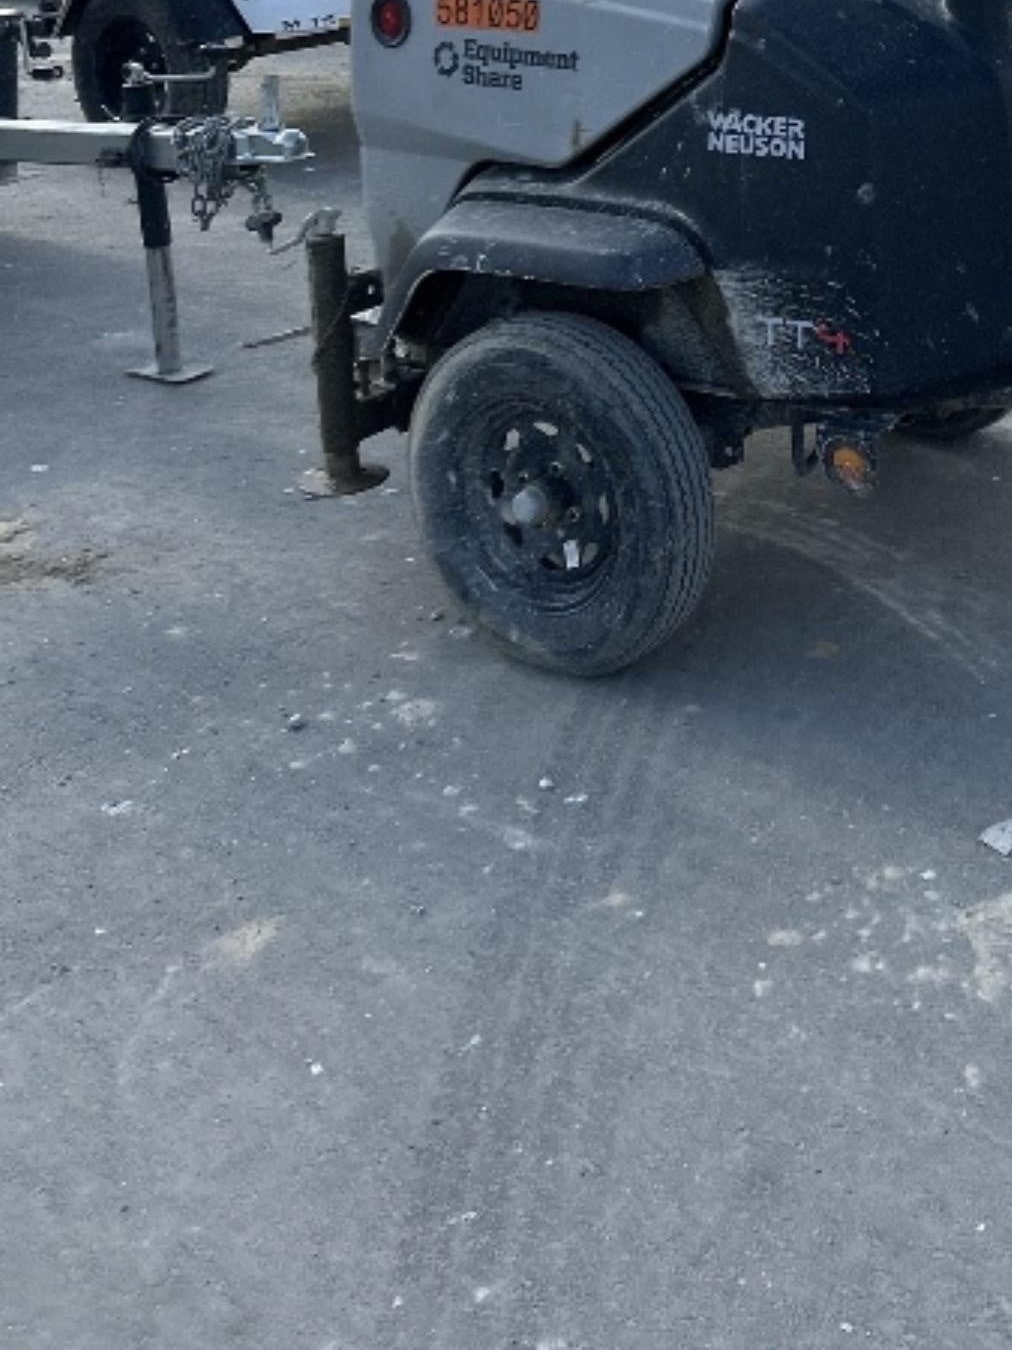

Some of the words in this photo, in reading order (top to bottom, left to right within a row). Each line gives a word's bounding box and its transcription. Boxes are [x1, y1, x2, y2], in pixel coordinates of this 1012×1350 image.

[463, 38, 578, 70] Equipment
[462, 64, 522, 90] Share
[708, 110, 805, 138] WACKER
[708, 131, 805, 160] NEUSON
